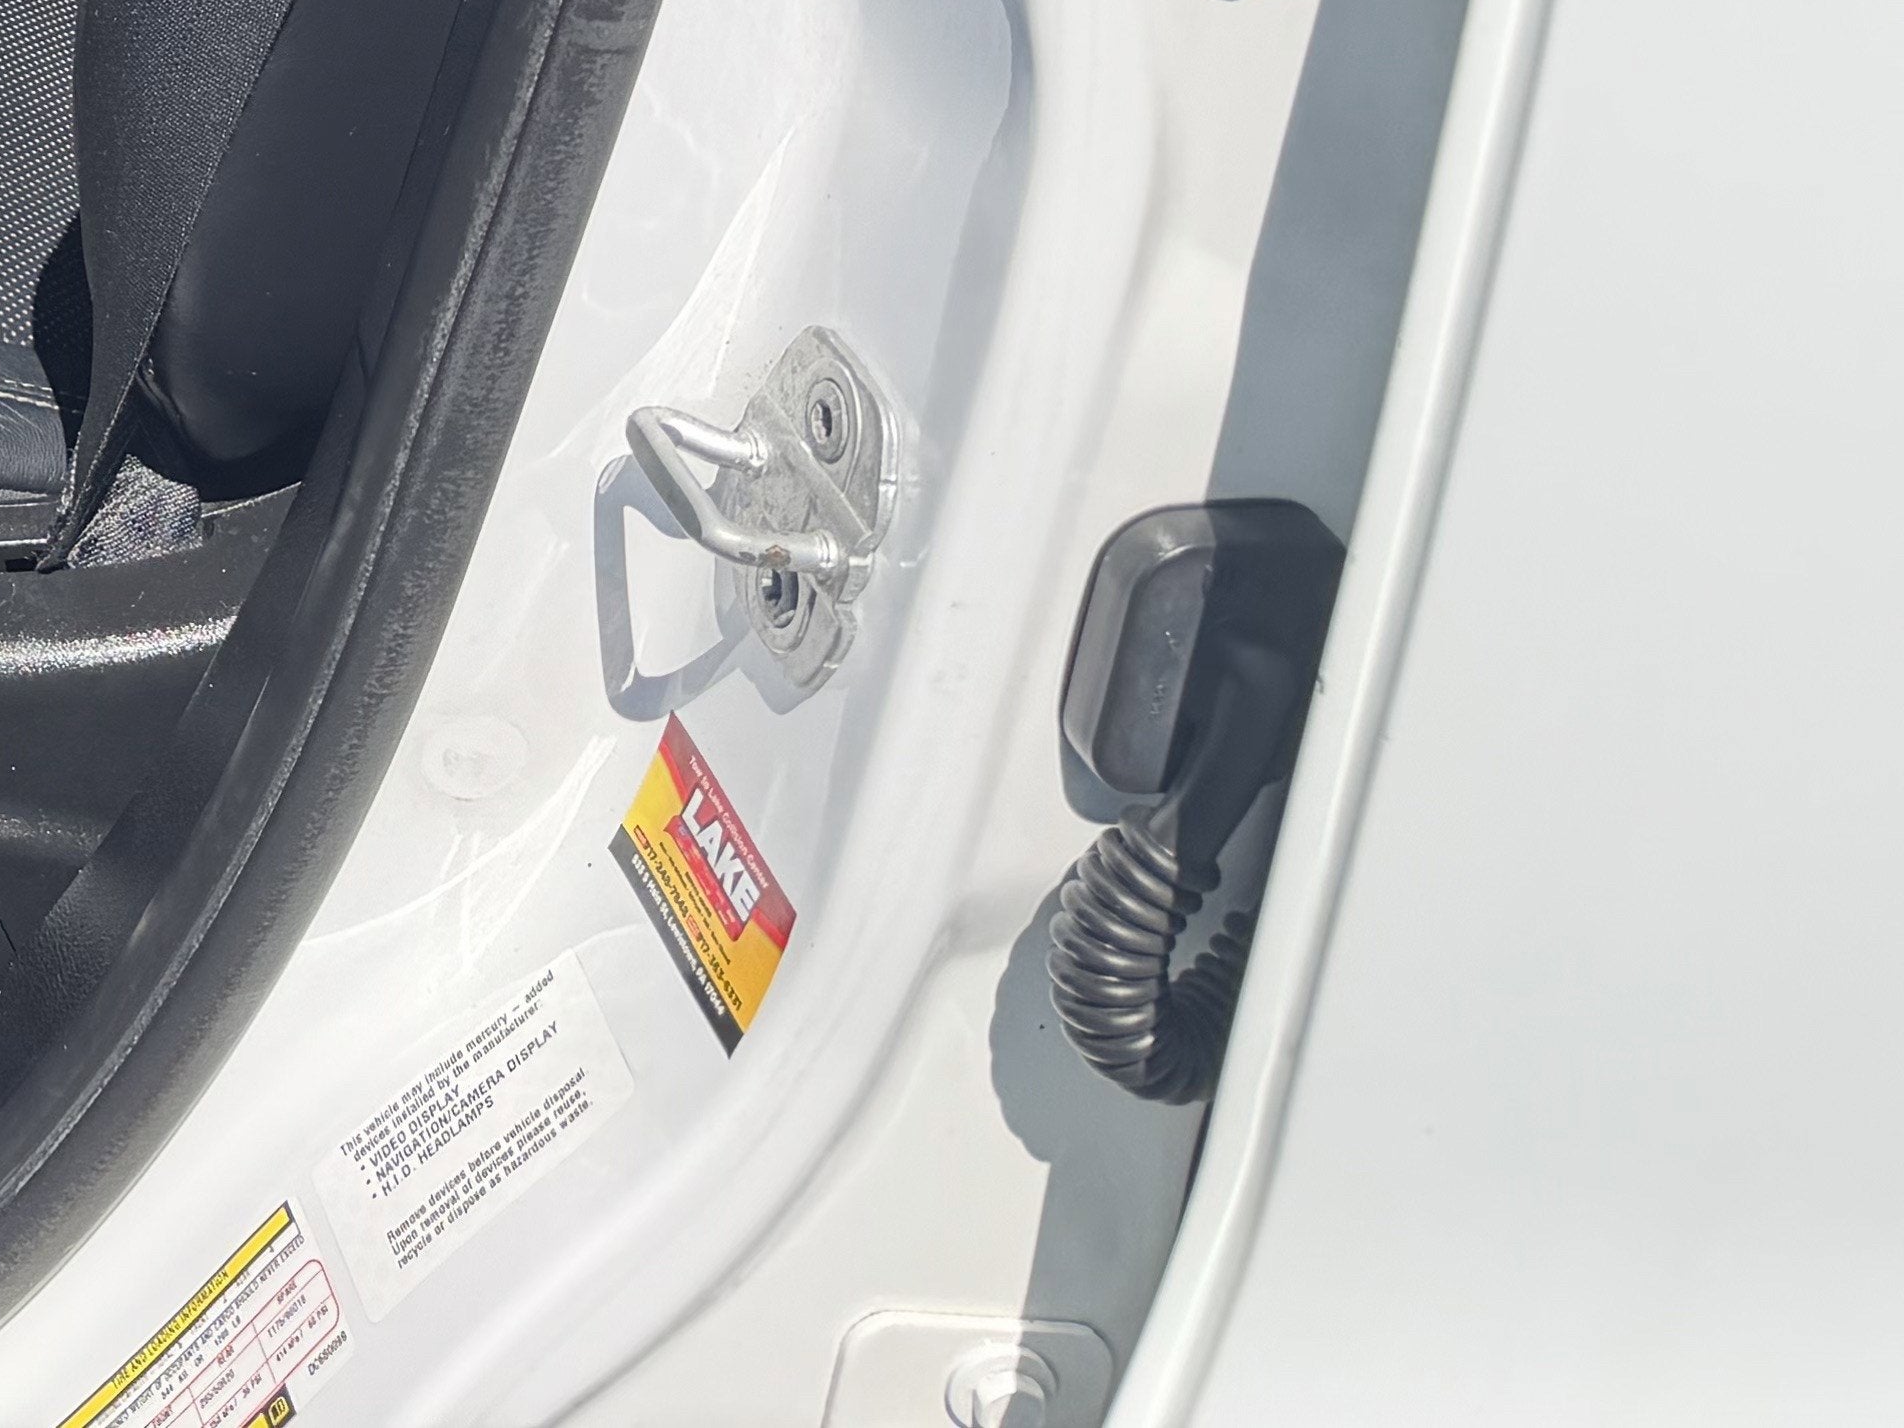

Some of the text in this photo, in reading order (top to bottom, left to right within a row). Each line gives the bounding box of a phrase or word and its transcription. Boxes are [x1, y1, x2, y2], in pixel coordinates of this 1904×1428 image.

[647, 880, 661, 905] Main
[683, 790, 759, 920] LAKE
[340, 1133, 362, 1156] This
[363, 1102, 399, 1135] vehicle
[401, 1082, 422, 1104] may
[425, 1050, 463, 1084] include
[466, 1014, 507, 1052] mercury
[525, 970, 553, 1003] added
[354, 1126, 390, 1161] devices
[392, 1086, 435, 1128] installed
[437, 1075, 450, 1090] by
[452, 1060, 469, 1078] the
[369, 1084, 458, 1166] VIDEO DISPLAY
[376, 1021, 556, 1181] NAVIGATION/CAMERA DISPLAY
[387, 1205, 426, 1243] Remove
[428, 1170, 466, 1206] devices
[468, 1141, 501, 1172] before
[503, 1109, 540, 1143] vehicle
[391, 1229, 418, 1255] Upon
[420, 1190, 460, 1231] removal
[462, 1178, 473, 1194] of
[475, 1147, 513, 1183] devices
[517, 1117, 551, 1151] please
[418, 1095, 493, 1164] HEADLAMPS
[398, 1233, 432, 1269] recycle
[434, 1221, 444, 1235] or
[447, 1186, 486, 1223] dispose
[490, 1173, 501, 1188] as
[503, 1128, 556, 1176] hazardous
